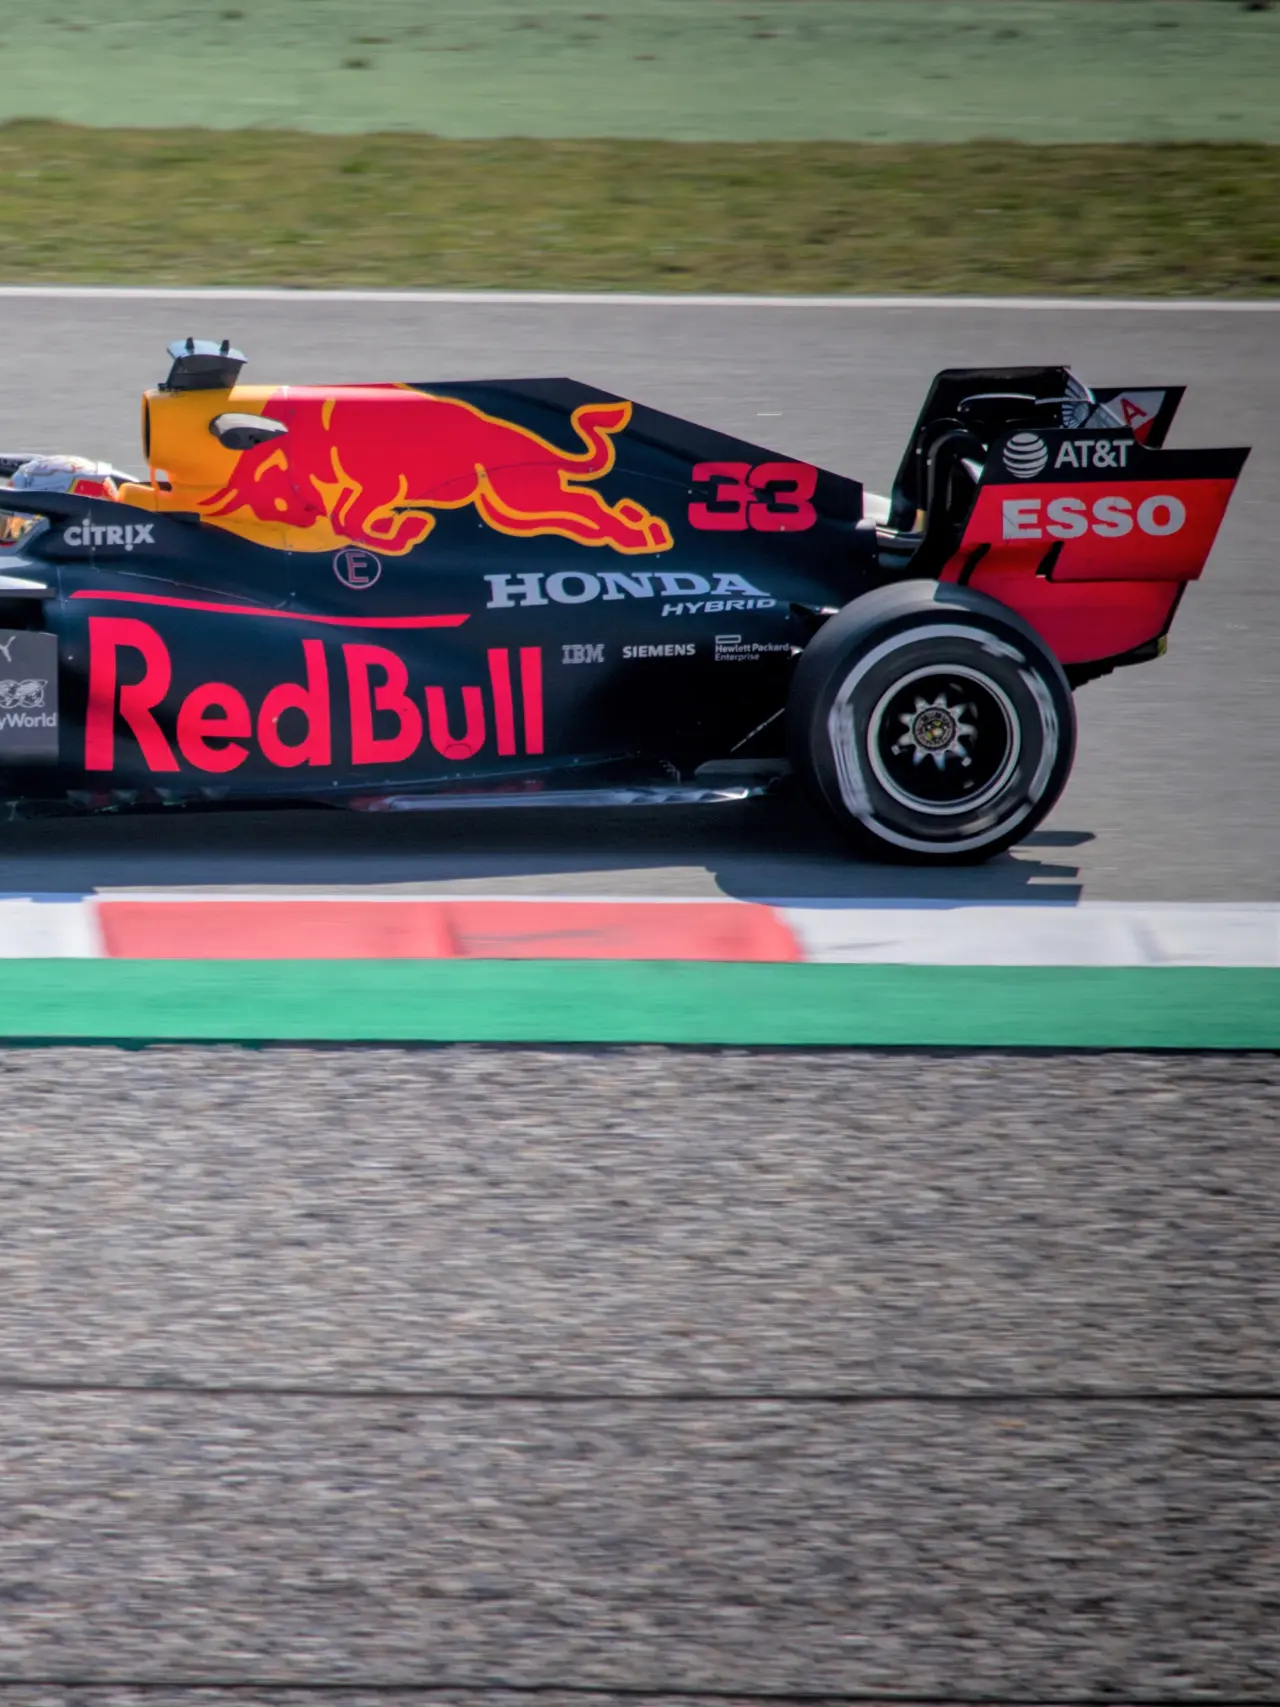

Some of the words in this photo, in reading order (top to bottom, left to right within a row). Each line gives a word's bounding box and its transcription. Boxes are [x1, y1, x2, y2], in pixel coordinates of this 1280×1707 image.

[1054, 439, 1135, 469] AT&T
[687, 462, 818, 532] 33
[1001, 495, 1187, 540] ESSO
[483, 571, 771, 609] HONDA
[661, 599, 778, 617] HYBRID
[562, 644, 605, 664] IBM
[622, 644, 696, 659] SIEMENS
[715, 644, 751, 653] Hewlett
[752, 643, 790, 652] Packard
[715, 653, 760, 662] Enterprise
